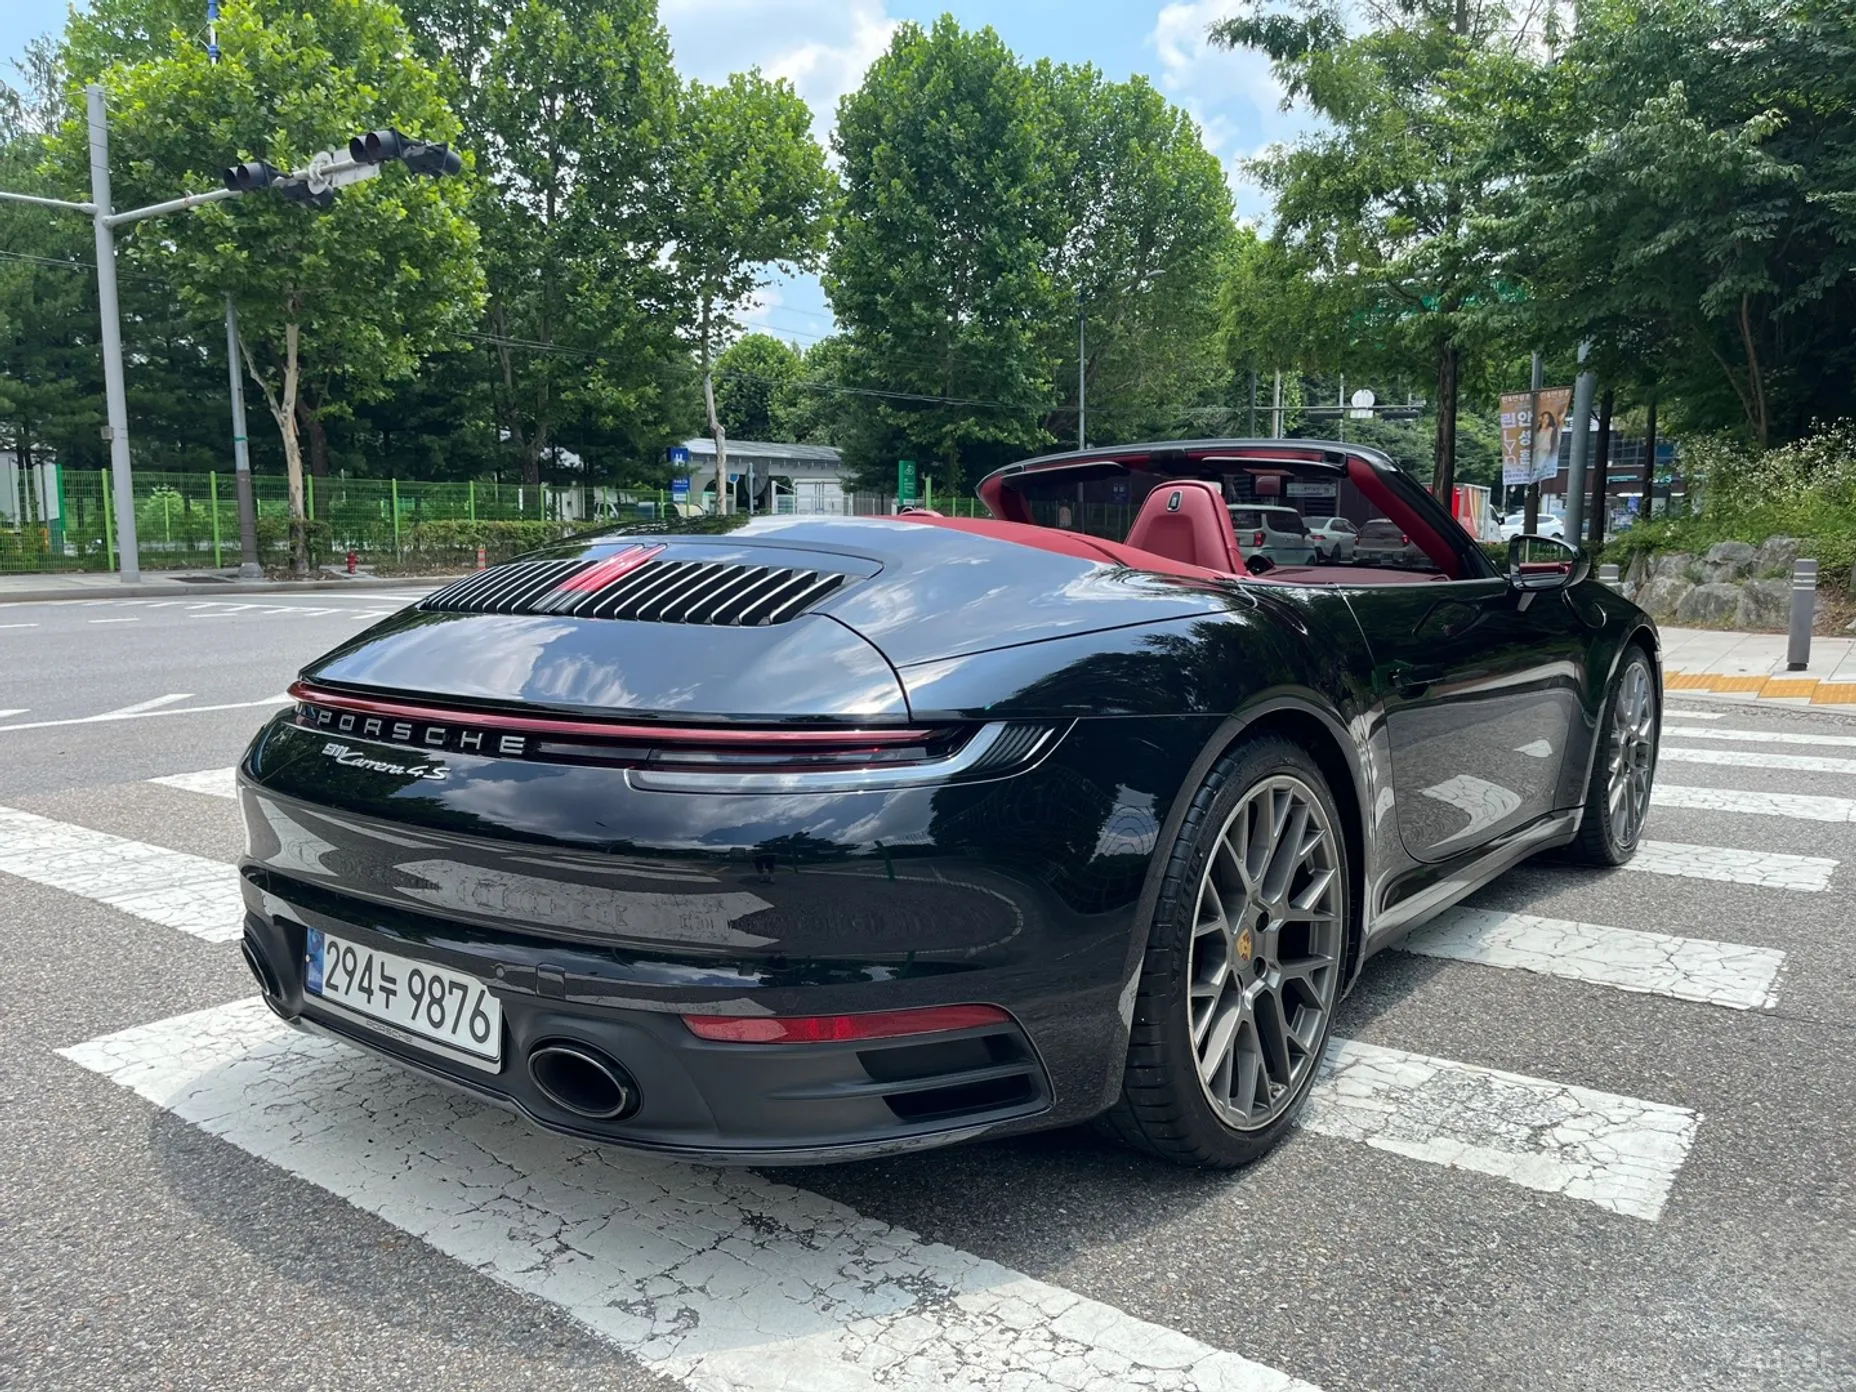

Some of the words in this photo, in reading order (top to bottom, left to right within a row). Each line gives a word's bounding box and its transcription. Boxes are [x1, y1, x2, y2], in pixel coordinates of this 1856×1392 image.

[316, 711, 525, 755] PORSCHE
[336, 752, 405, 775] Carrera
[408, 968, 491, 1044] 9876
[366, 1019, 413, 1044] PORSCHE
